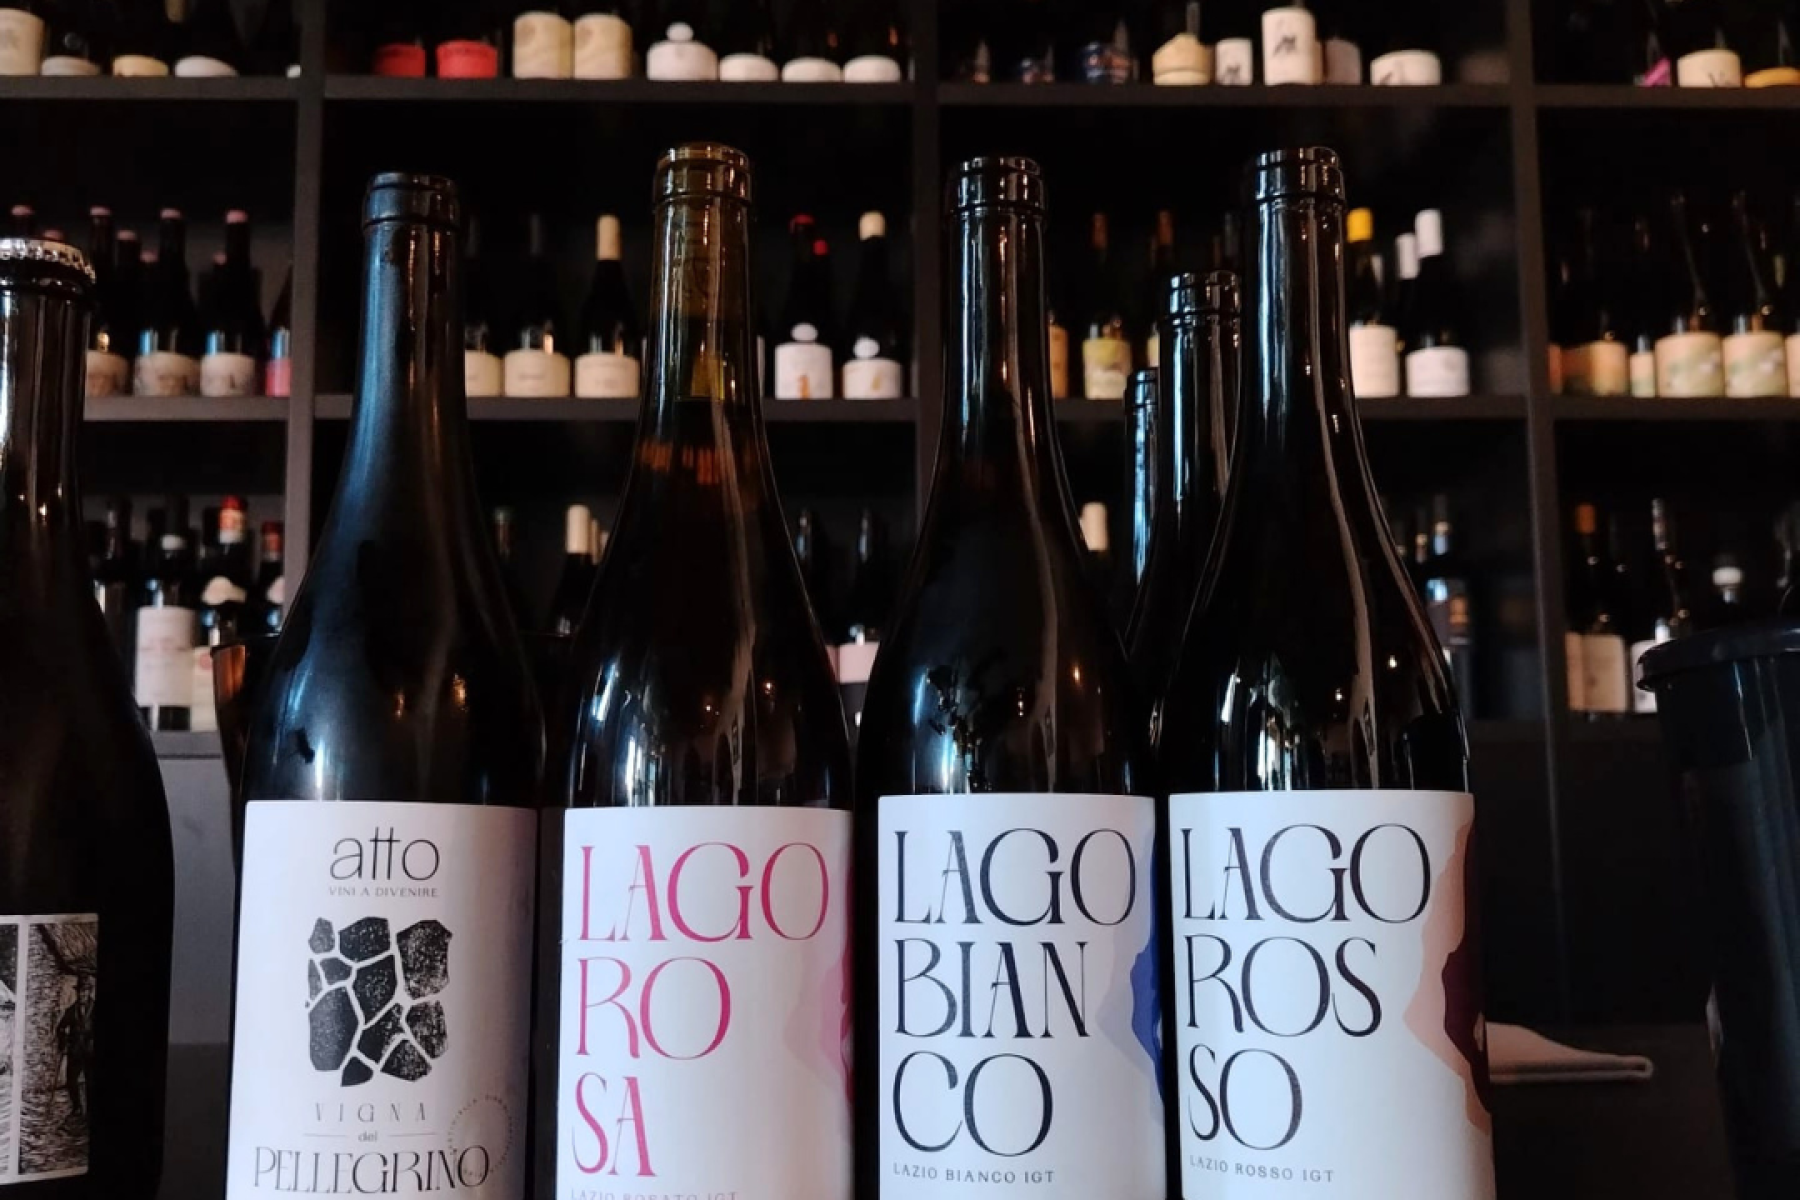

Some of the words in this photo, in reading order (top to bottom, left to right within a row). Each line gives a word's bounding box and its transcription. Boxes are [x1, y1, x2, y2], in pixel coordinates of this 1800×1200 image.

[329, 827, 440, 881] atto
[329, 885, 356, 897] VINI
[360, 886, 370, 897] A
[374, 887, 439, 898] DIVENIRE
[578, 841, 829, 943] LAGO
[894, 828, 1136, 926] LAGO
[1181, 823, 1431, 924] LAGO
[575, 956, 731, 1061] RO
[894, 937, 1091, 1039] BIAN
[1184, 933, 1382, 1037] ROS
[315, 1102, 426, 1123] VIGNA
[358, 1131, 378, 1142] del
[571, 1071, 657, 1177] SA
[893, 1050, 1053, 1157] CO
[1187, 1043, 1302, 1150] SO
[254, 1145, 490, 1194] PELLEGRINO
[893, 1162, 938, 1179] LAZIO
[945, 1168, 1016, 1184] BIANCO
[1024, 1170, 1055, 1184] IGT
[1189, 1155, 1229, 1173] LAZIO
[1234, 1162, 1294, 1181] ROSSO
[1302, 1169, 1334, 1183] IGT
